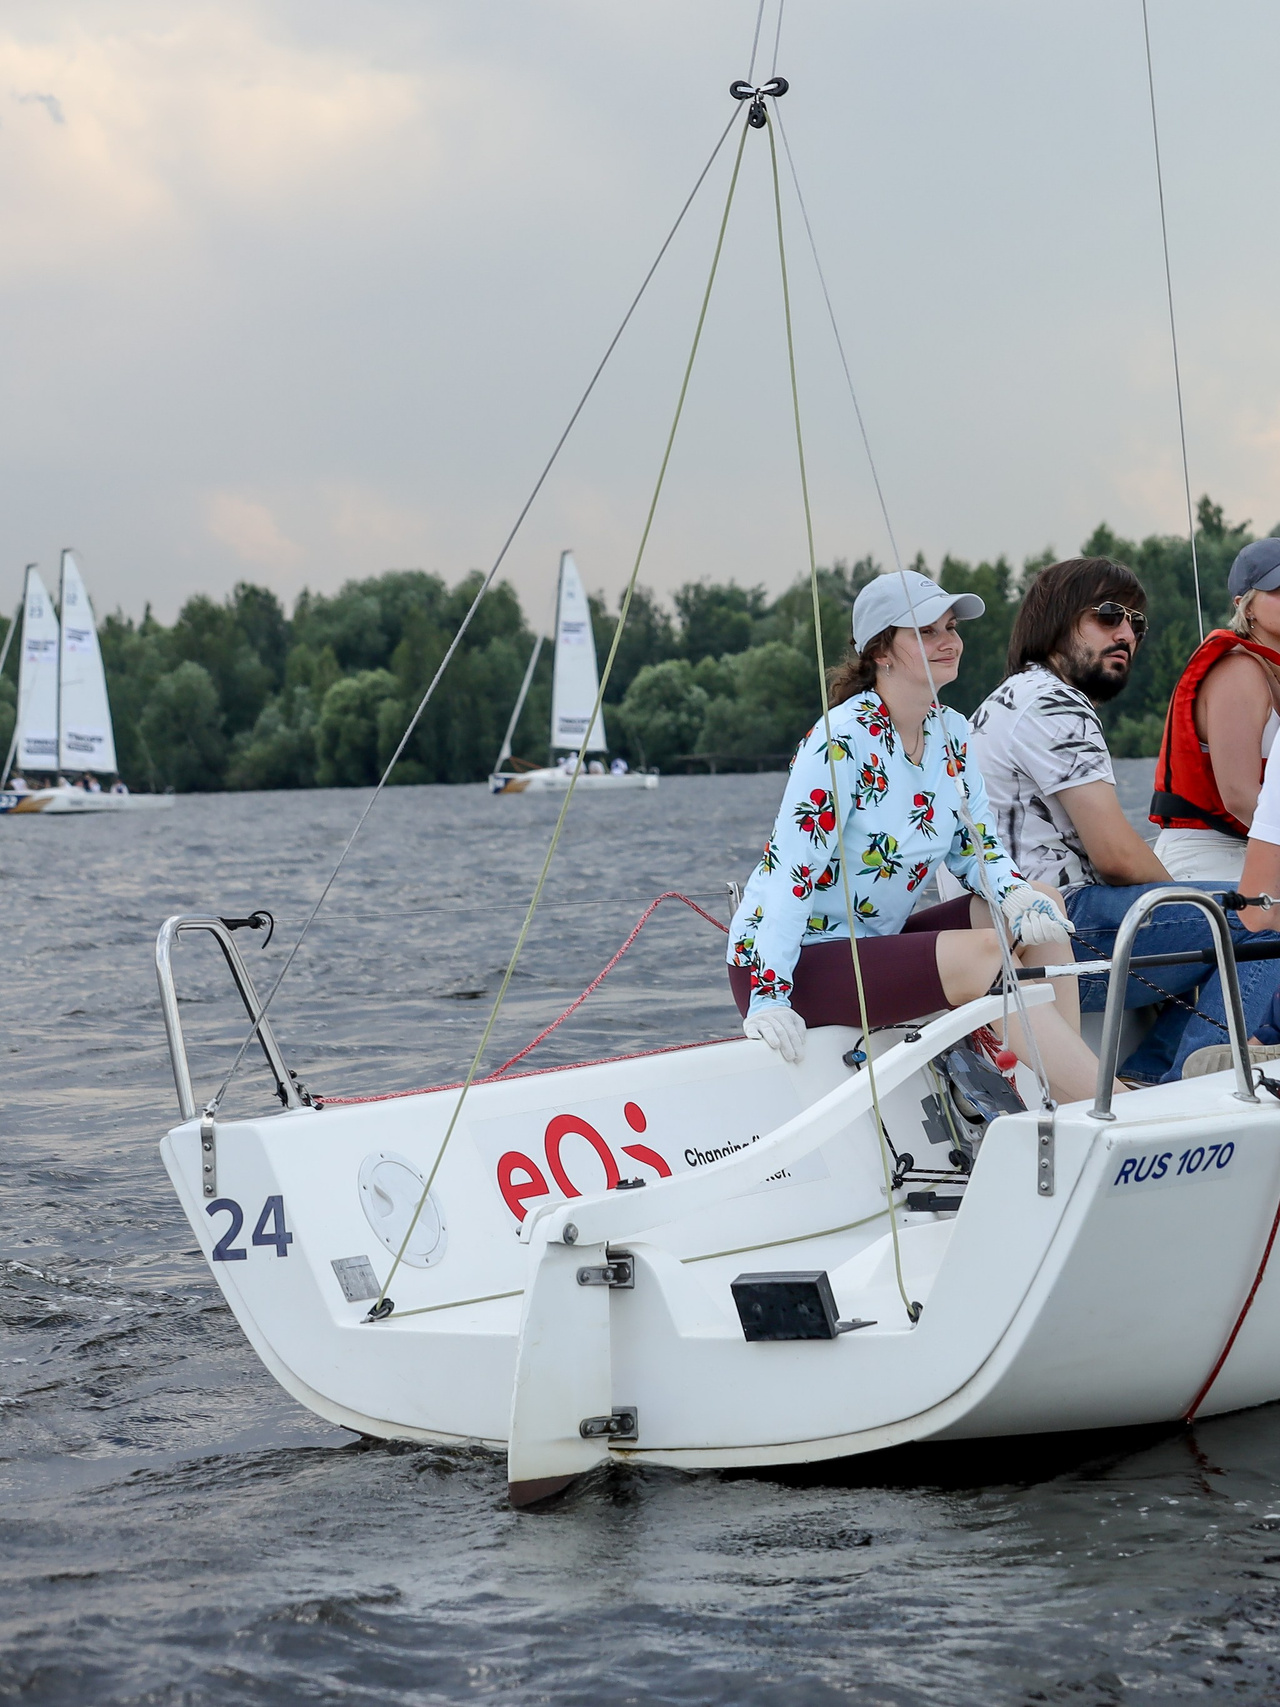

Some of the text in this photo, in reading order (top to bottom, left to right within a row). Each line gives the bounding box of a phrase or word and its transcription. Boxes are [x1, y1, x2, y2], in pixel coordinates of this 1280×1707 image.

[1114, 1141, 1235, 1186] RUS 1070
[205, 1195, 293, 1261] 24
